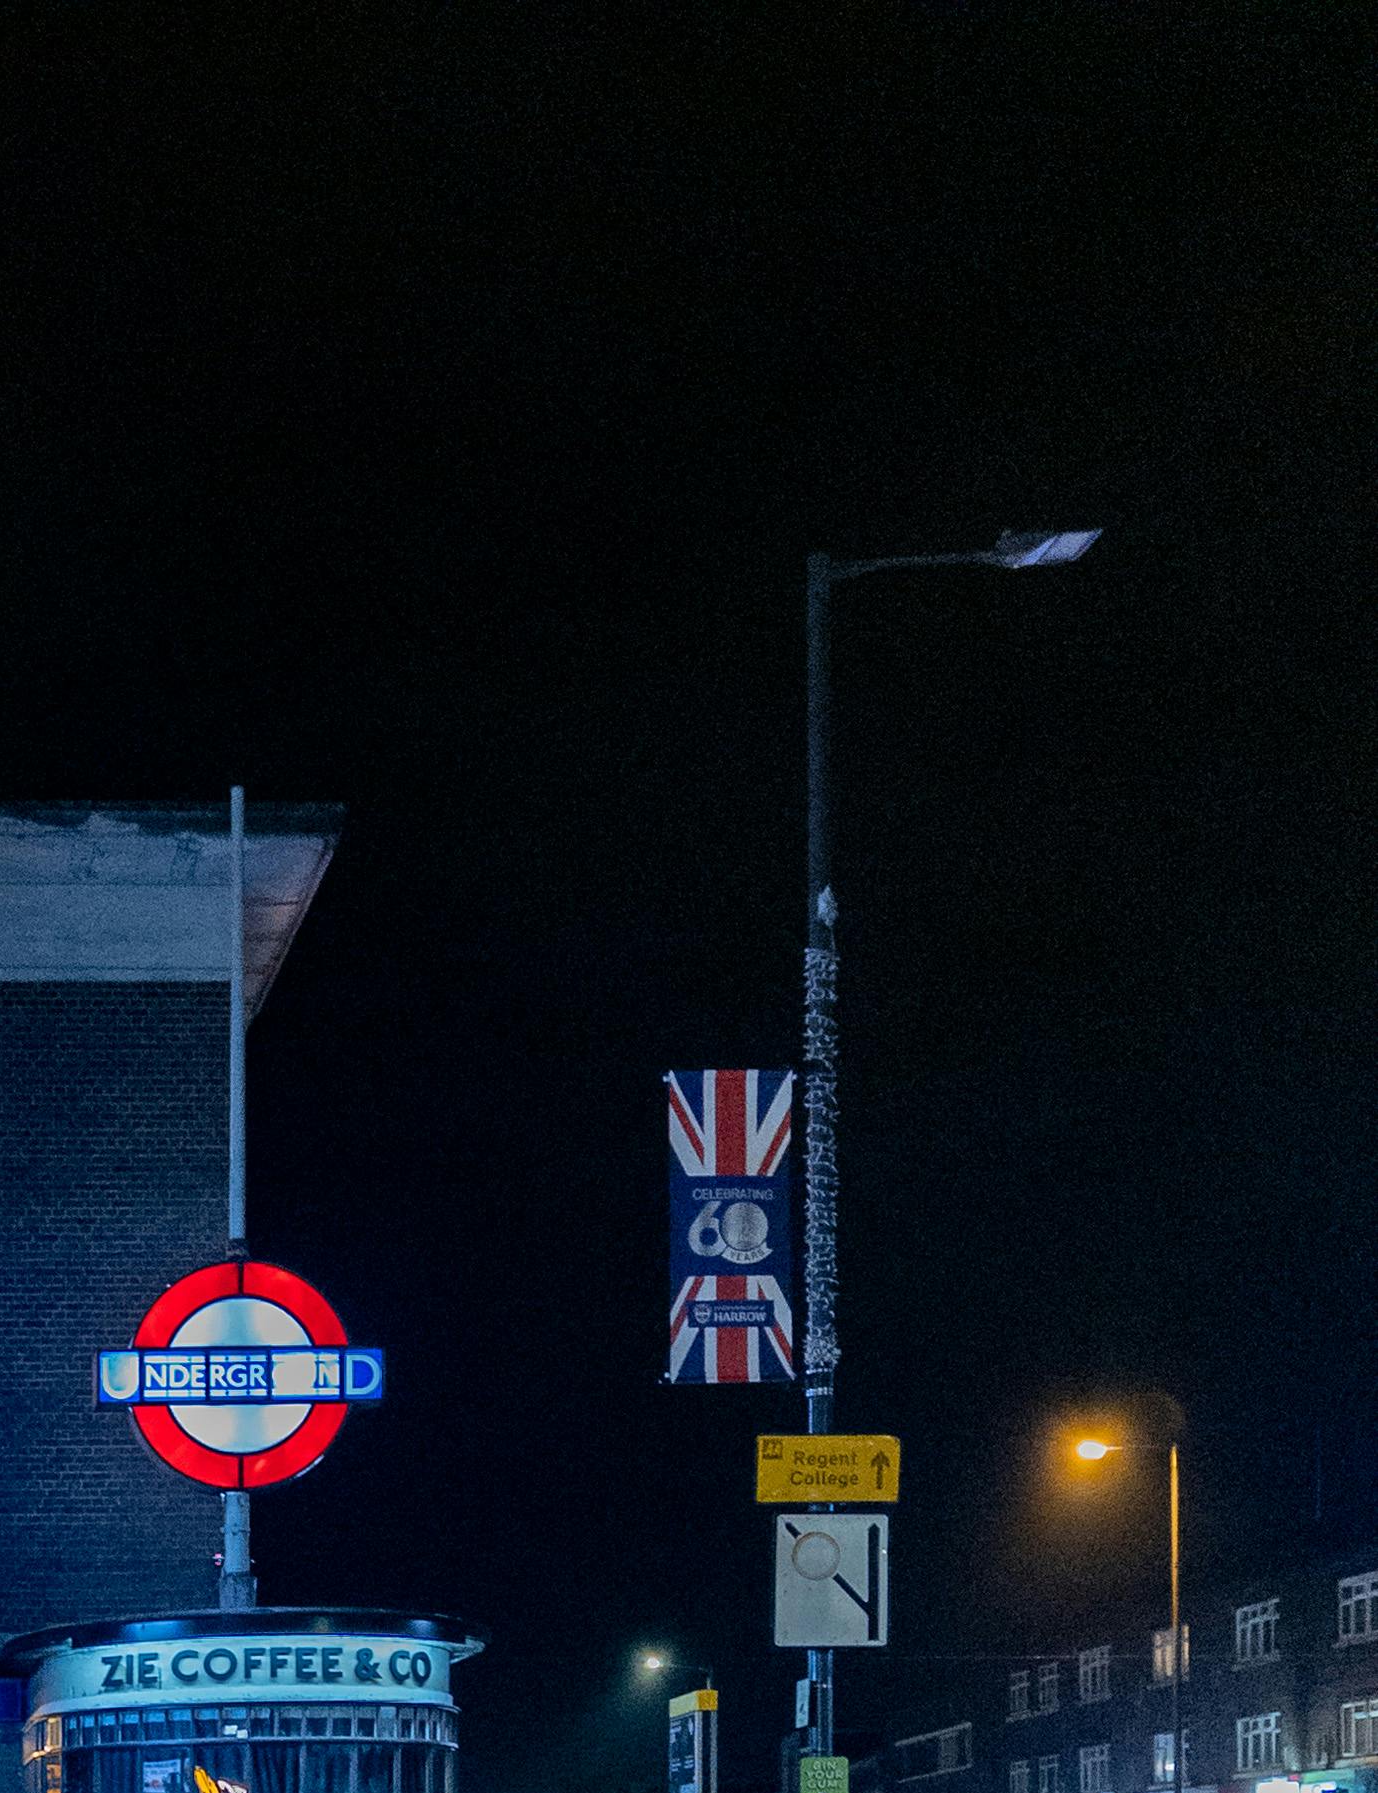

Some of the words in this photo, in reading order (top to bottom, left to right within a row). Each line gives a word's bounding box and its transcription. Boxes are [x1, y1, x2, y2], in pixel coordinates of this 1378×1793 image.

[692, 1187, 775, 1200] CELEBRATING
[729, 1249, 769, 1263] YEARS
[713, 1311, 767, 1322] HARROW
[102, 1354, 381, 1400] UNDERGRND
[793, 1450, 859, 1469] Regent
[789, 1471, 860, 1488] College
[101, 1652, 161, 1688] ZIE
[171, 1647, 344, 1683] COFFEE
[353, 1648, 383, 1682] &
[388, 1650, 433, 1686] CO
[813, 1760, 837, 1770] BIN
[805, 1770, 844, 1780] YOUR
